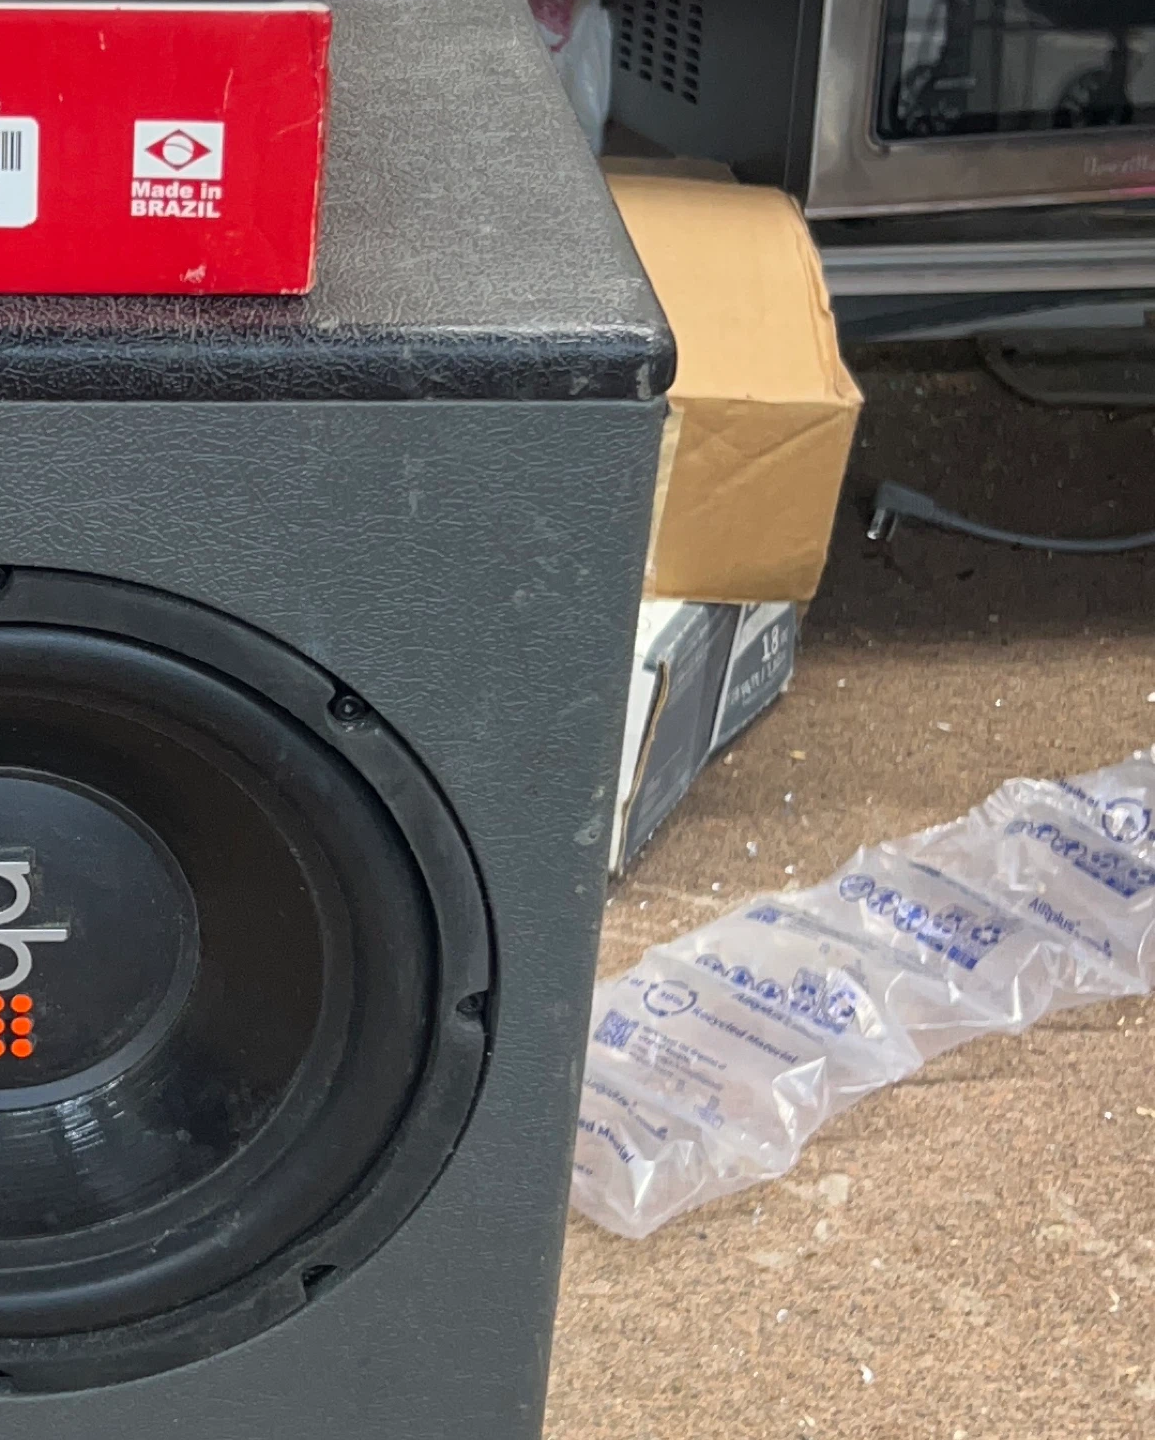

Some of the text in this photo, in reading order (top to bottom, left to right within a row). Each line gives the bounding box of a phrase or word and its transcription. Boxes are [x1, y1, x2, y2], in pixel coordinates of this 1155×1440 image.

[131, 180, 222, 200] Made in
[130, 199, 222, 218] BRAZIL
